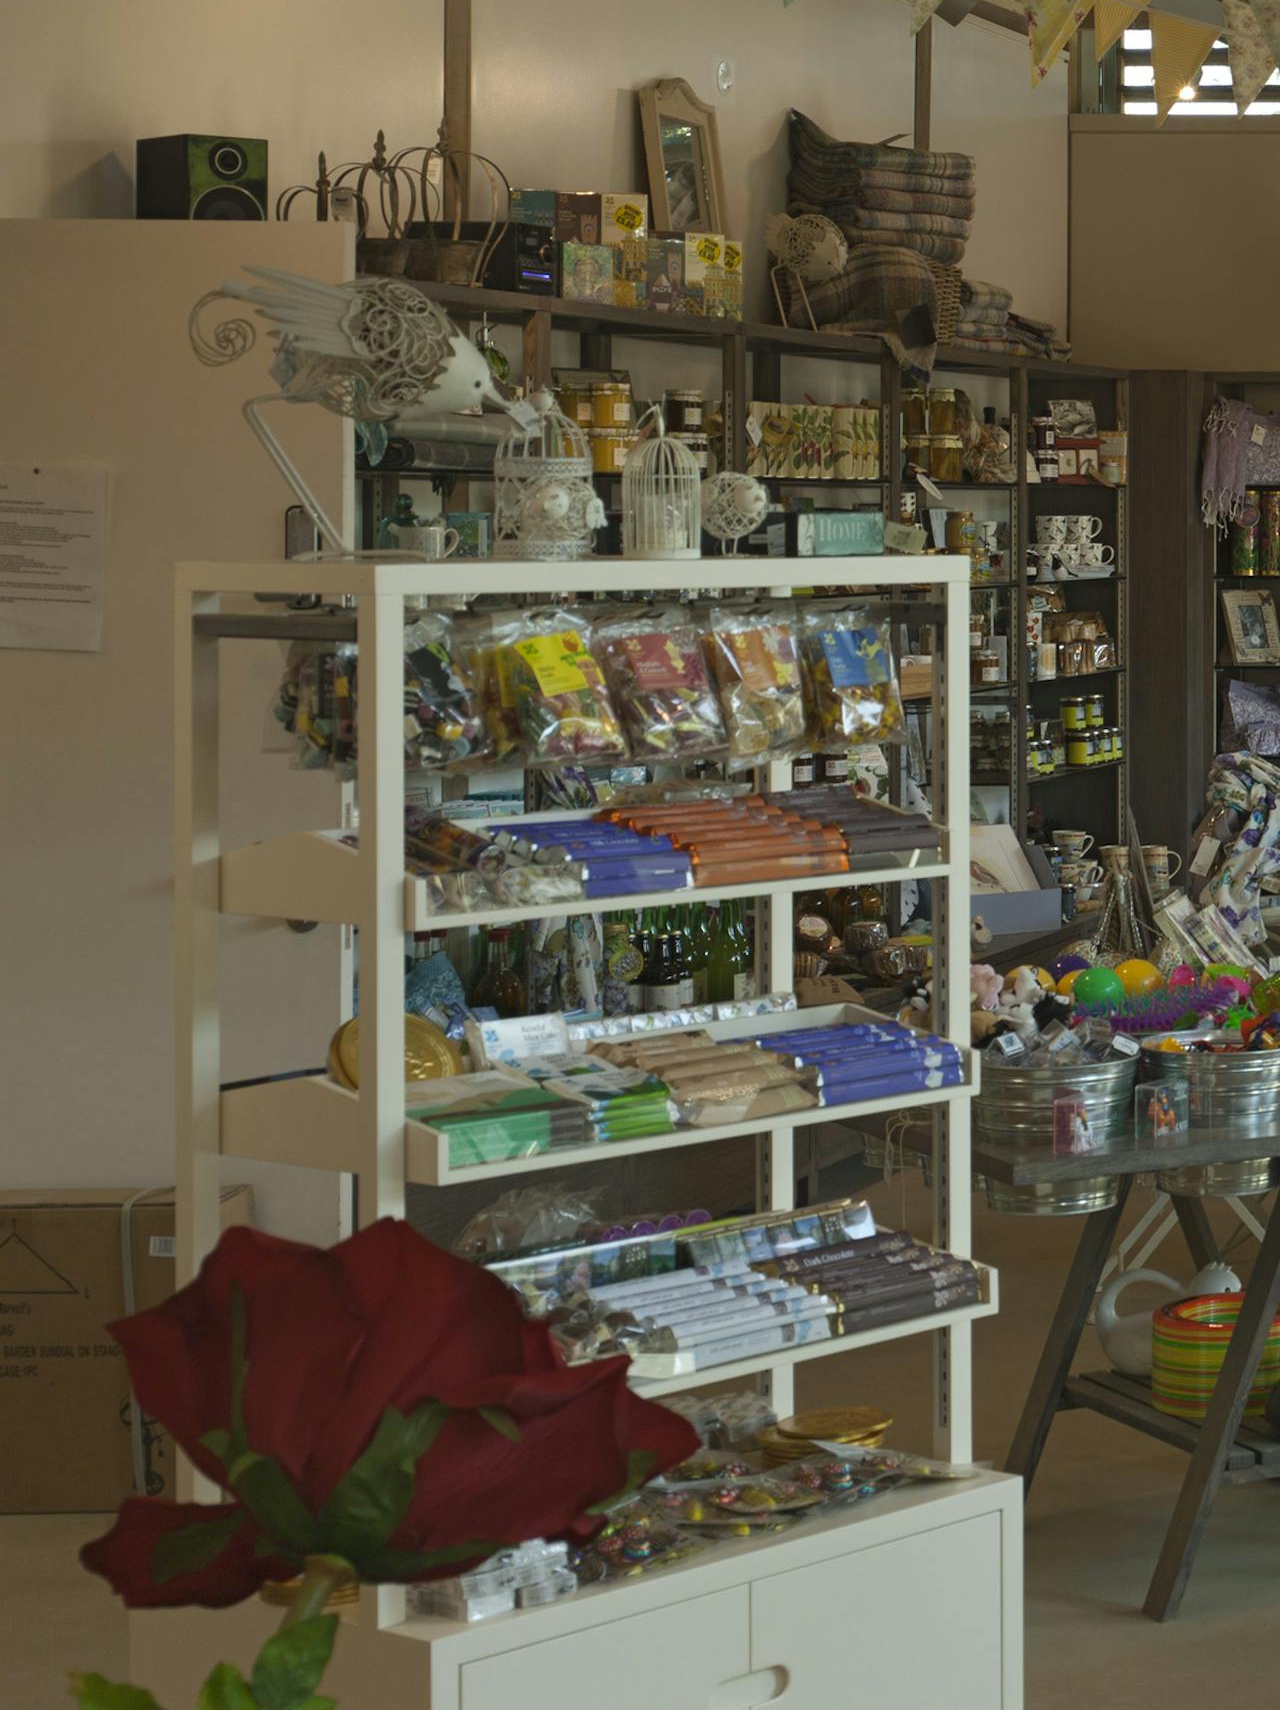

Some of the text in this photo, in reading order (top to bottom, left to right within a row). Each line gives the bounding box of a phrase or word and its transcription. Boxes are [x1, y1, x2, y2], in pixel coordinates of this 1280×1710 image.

[818, 518, 867, 542] HOME
[802, 1249, 855, 1268] Dark Chocolate
[3, 1345, 36, 1358] GARDEN
